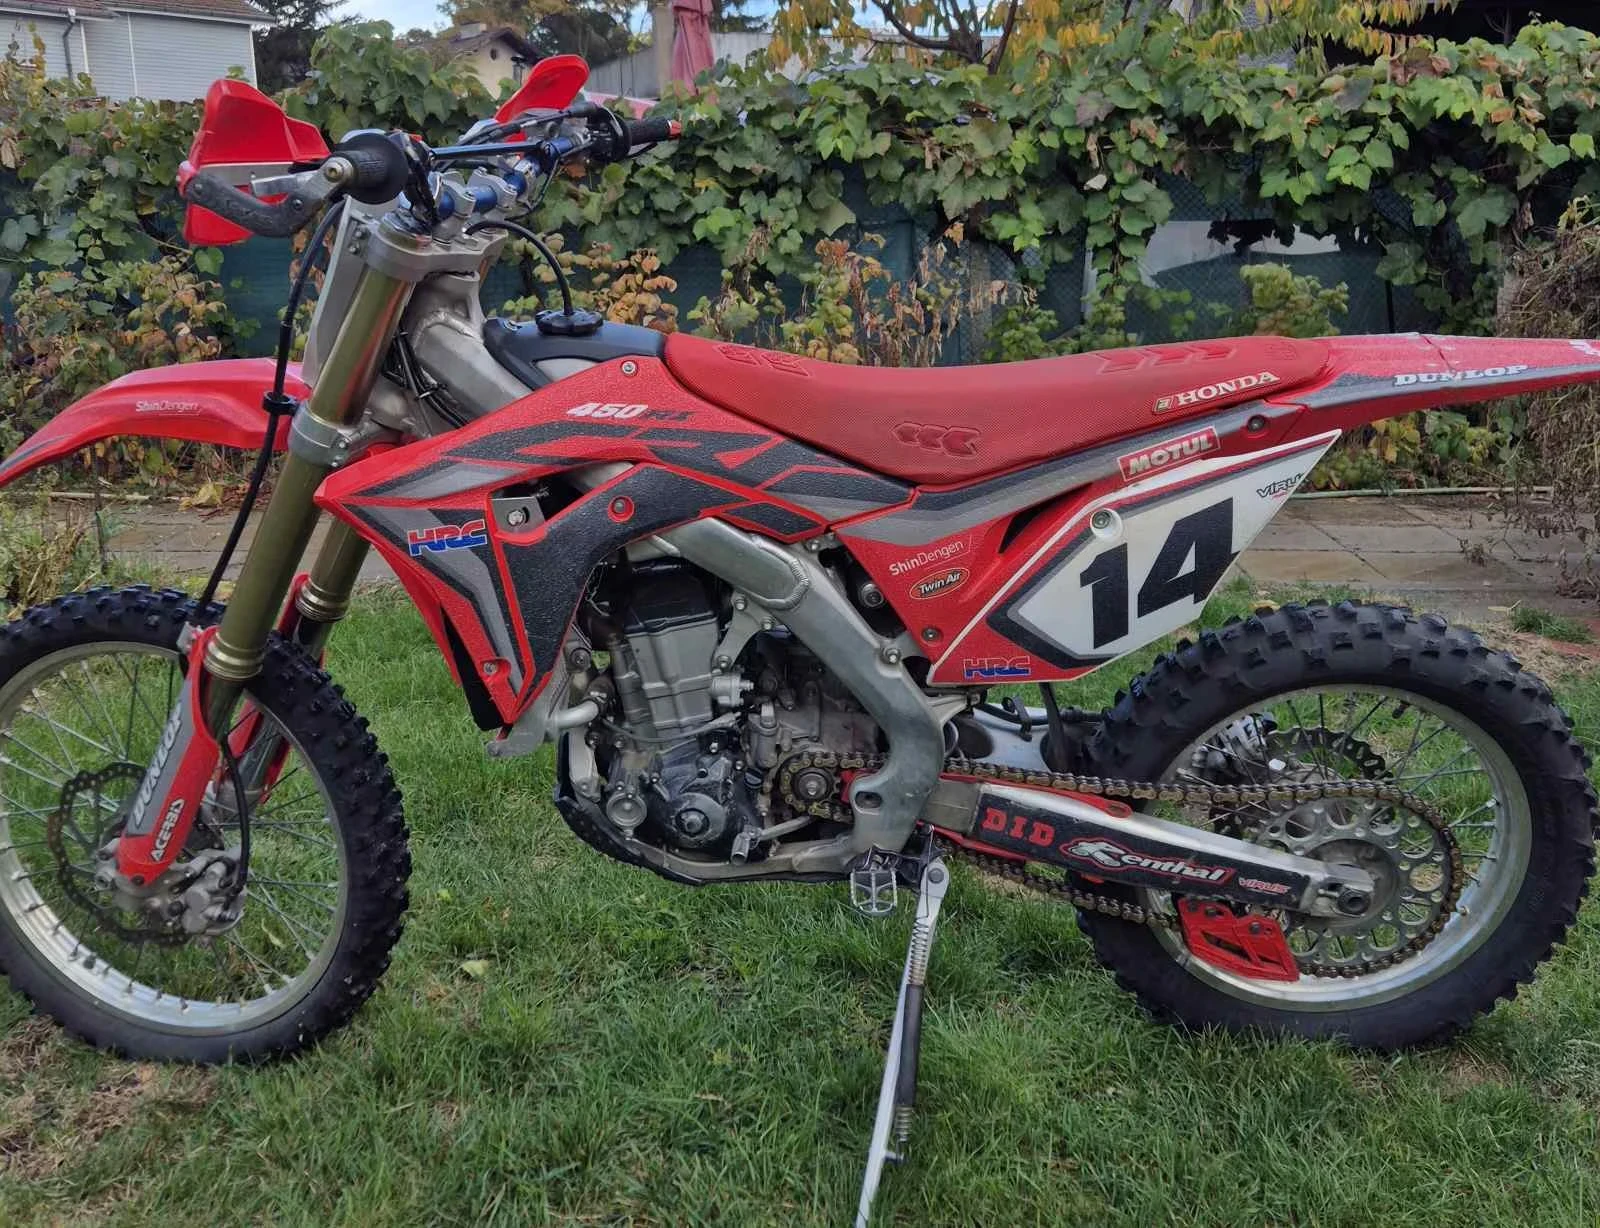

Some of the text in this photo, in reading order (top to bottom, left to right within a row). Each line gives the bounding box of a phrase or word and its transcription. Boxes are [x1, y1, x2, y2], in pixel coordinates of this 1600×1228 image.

[1174, 371, 1281, 407] HONDA
[1394, 364, 1528, 387] DUNLOP
[565, 402, 649, 419] 450
[1128, 434, 1214, 476] MOTUL
[1256, 473, 1304, 499] VIRU
[406, 518, 488, 557] HRC
[888, 540, 965, 577] ShinDengen
[1079, 496, 1241, 650] 14
[918, 570, 962, 595] Twin Air
[962, 655, 1032, 680] HRC
[133, 702, 183, 828] DUNLOP
[150, 798, 186, 863] ACERBIS
[1066, 840, 1227, 881] Renthal
